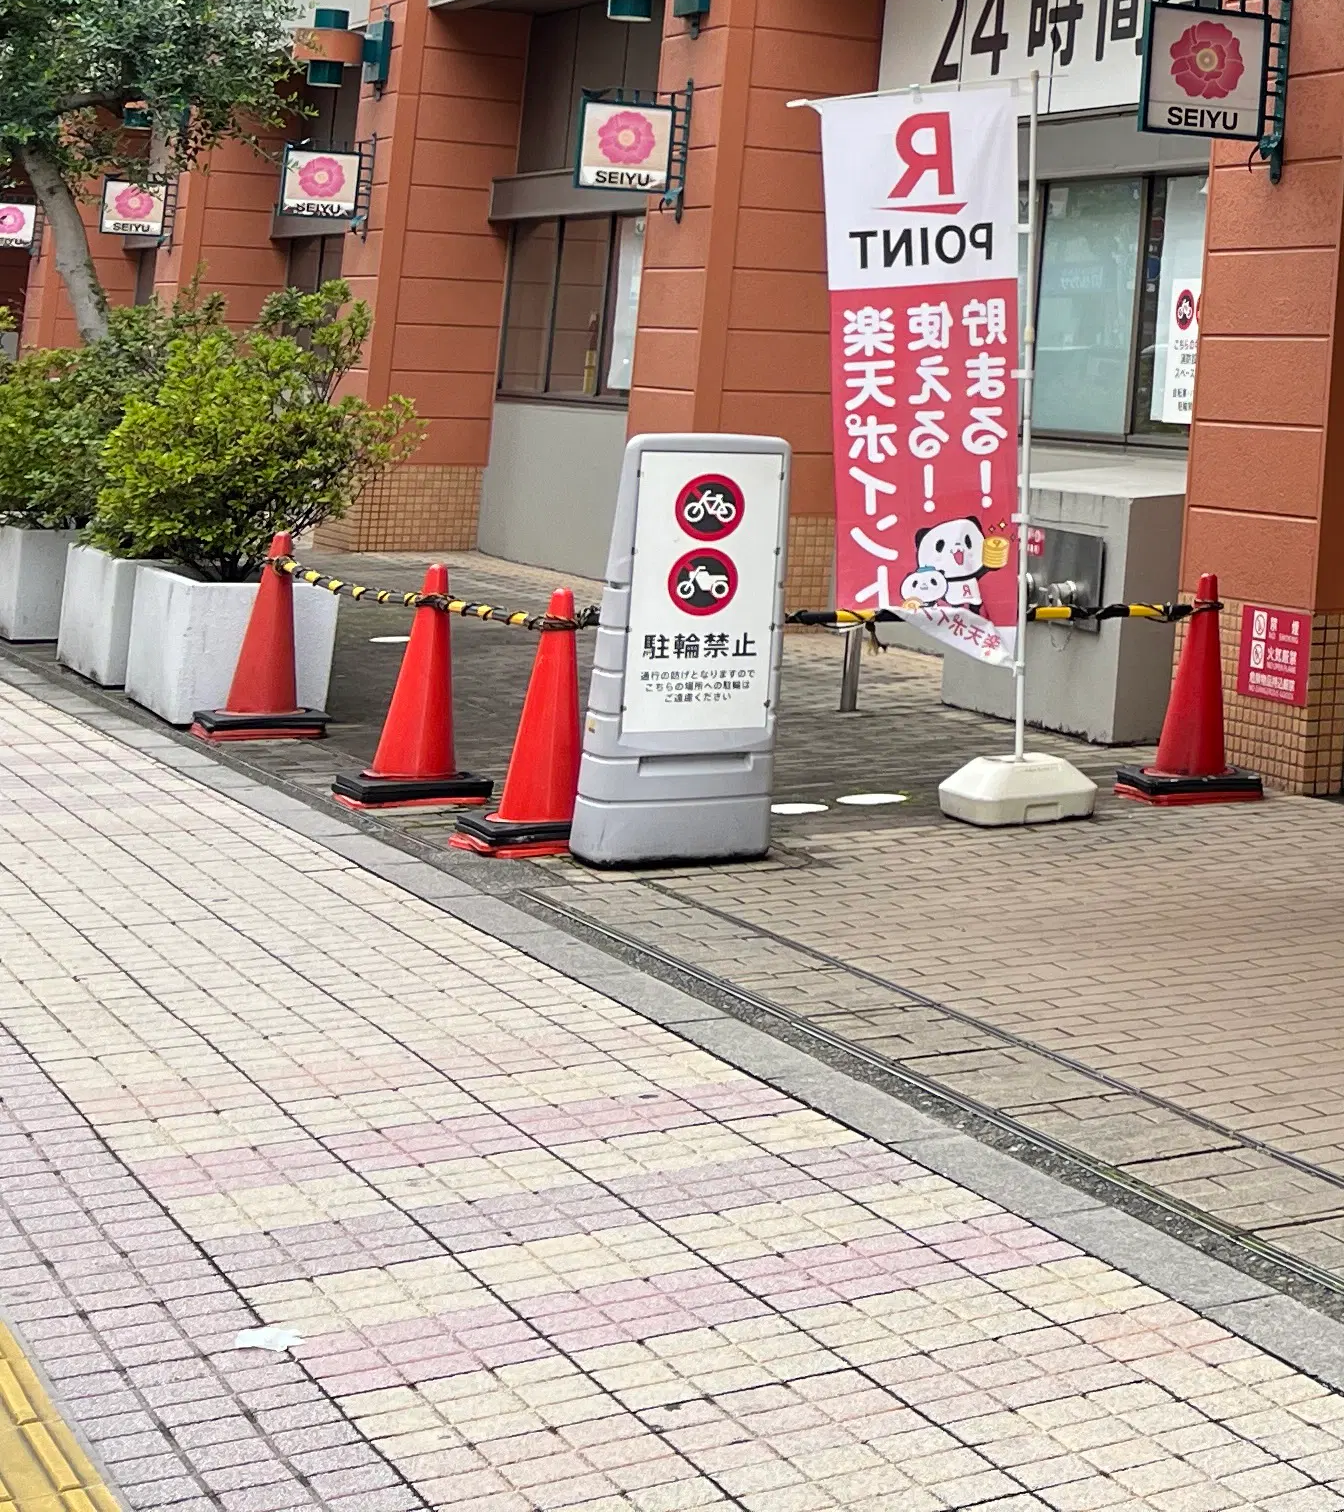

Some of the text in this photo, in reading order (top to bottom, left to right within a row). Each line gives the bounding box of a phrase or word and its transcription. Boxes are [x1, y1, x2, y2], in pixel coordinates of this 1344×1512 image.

[1168, 106, 1238, 131] SEIYU
[595, 170, 650, 186] SEIYU
[112, 221, 151, 233] SEIYU
[642, 632, 757, 659] 駐輪禁止
